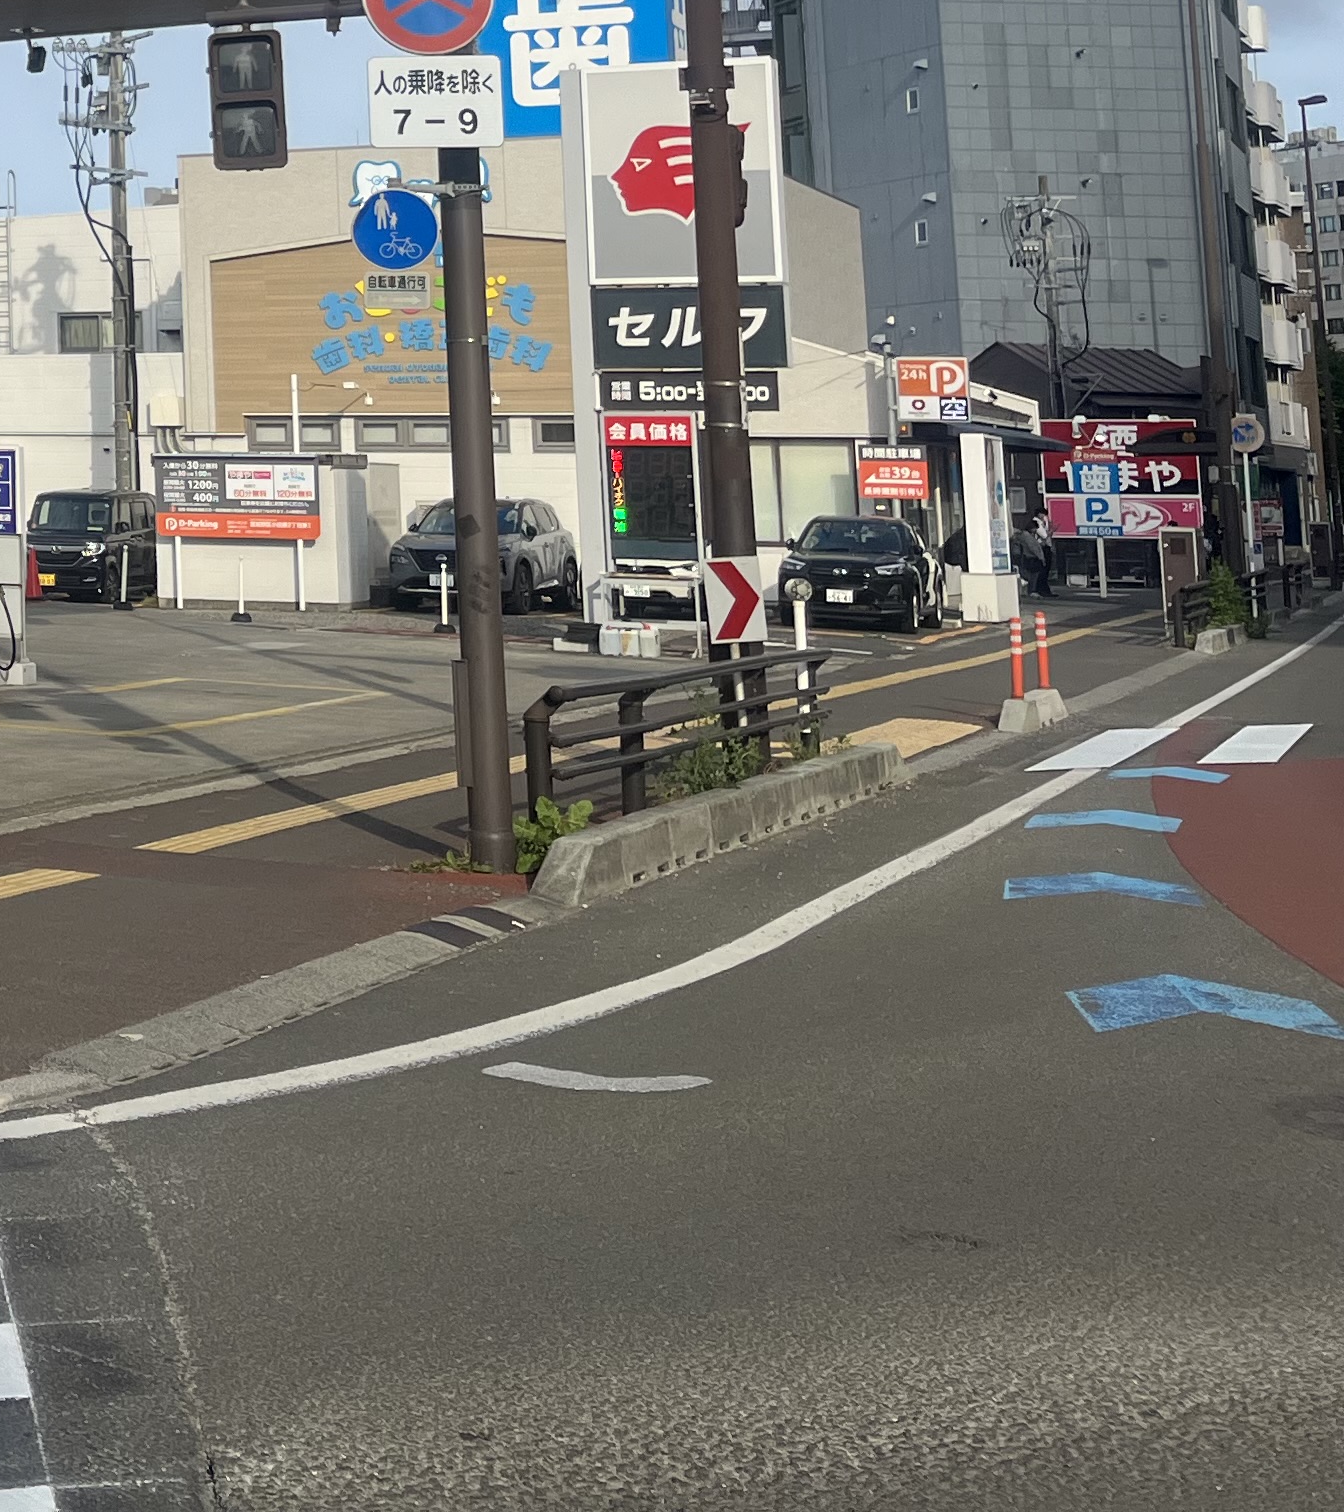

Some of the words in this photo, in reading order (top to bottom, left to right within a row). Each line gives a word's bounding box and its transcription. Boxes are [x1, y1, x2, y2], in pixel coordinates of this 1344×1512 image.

[374, 69, 494, 96] 人の乗降を除く
[368, 276, 427, 289] 自転車通行可
[311, 318, 553, 375] 歯科・矯歯科
[900, 369, 928, 381] 24h
[608, 423, 688, 441] 会員価格
[1079, 464, 1111, 493] 歯
[1085, 497, 1110, 523] P
[1182, 502, 1195, 513] 2F
